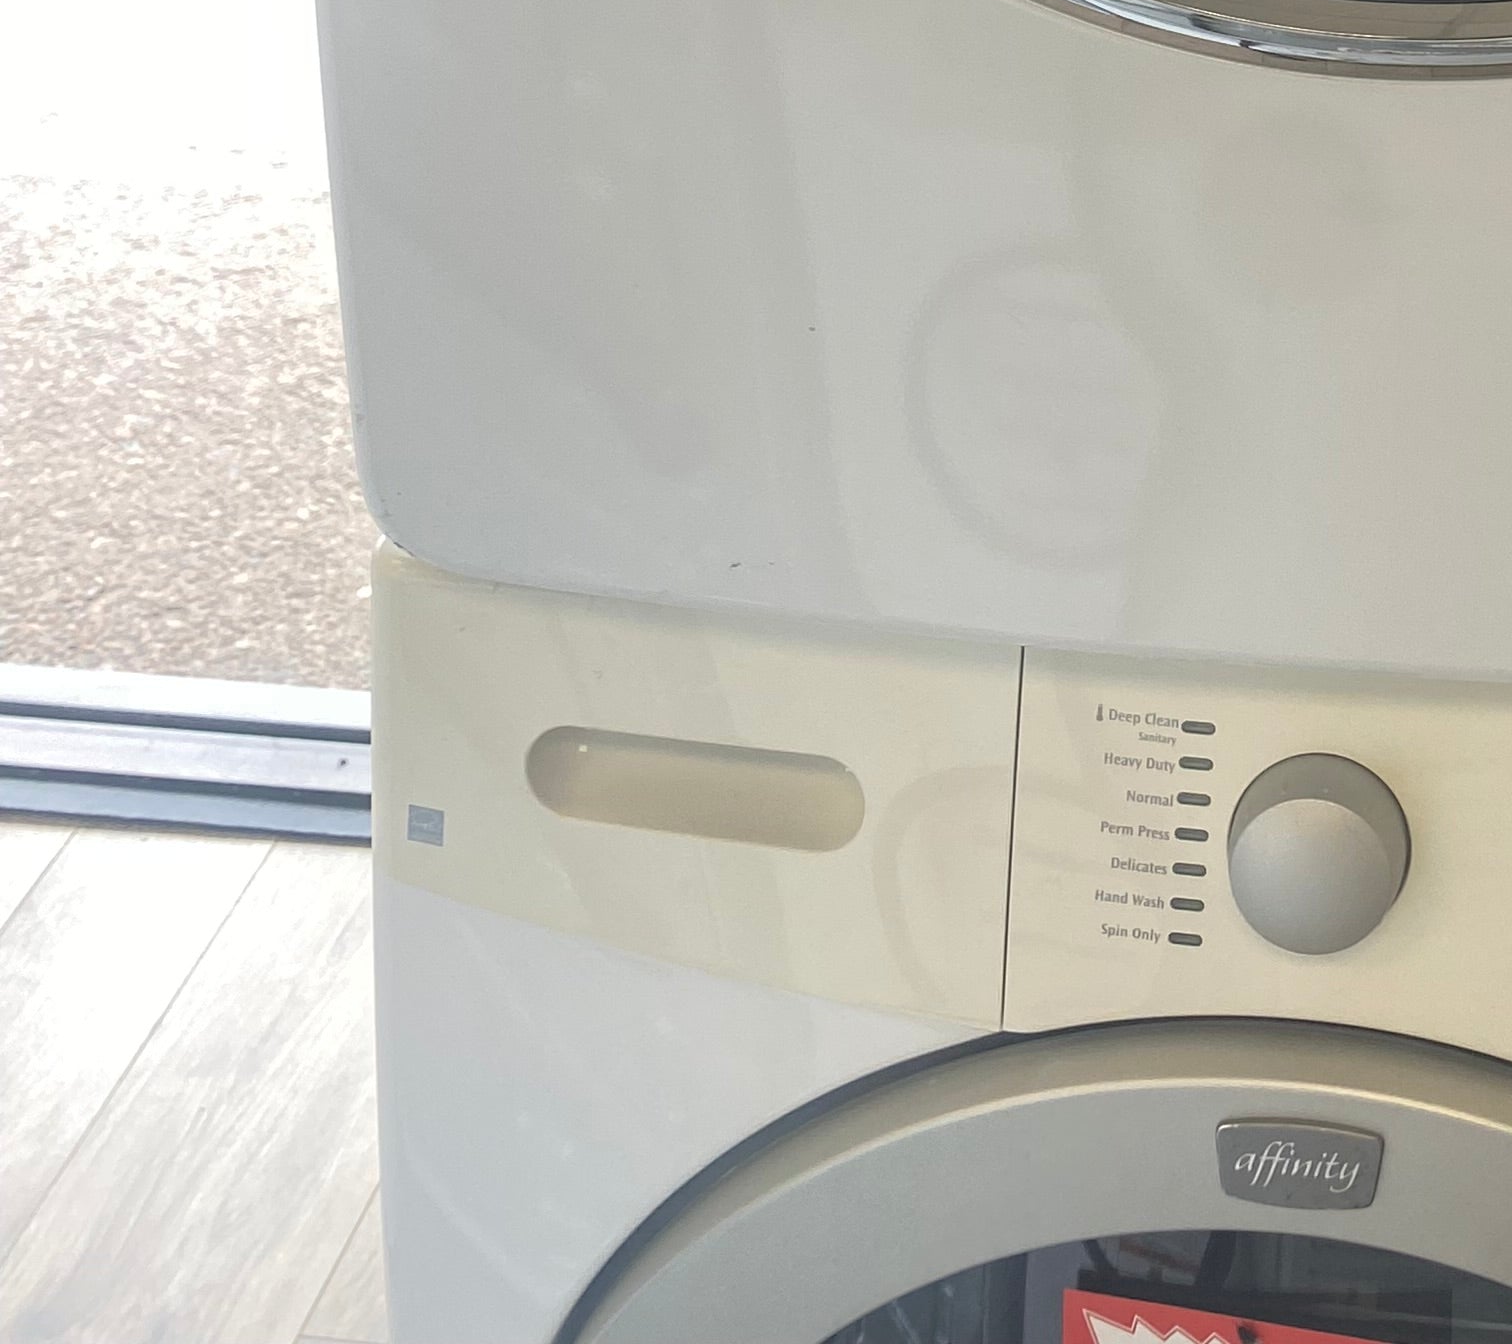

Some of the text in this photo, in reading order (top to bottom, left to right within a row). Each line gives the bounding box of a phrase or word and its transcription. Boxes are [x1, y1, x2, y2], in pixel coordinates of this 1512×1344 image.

[1109, 709, 1179, 729] Deep Clean
[1104, 753, 1175, 774] Heavy Duty
[1126, 791, 1173, 807] Normal
[1101, 821, 1170, 841] Perm Press
[1111, 857, 1167, 875] Delicates
[1095, 890, 1164, 909] Hand Wash
[1102, 924, 1160, 943] Spin Only
[1234, 1141, 1360, 1193] affinity
